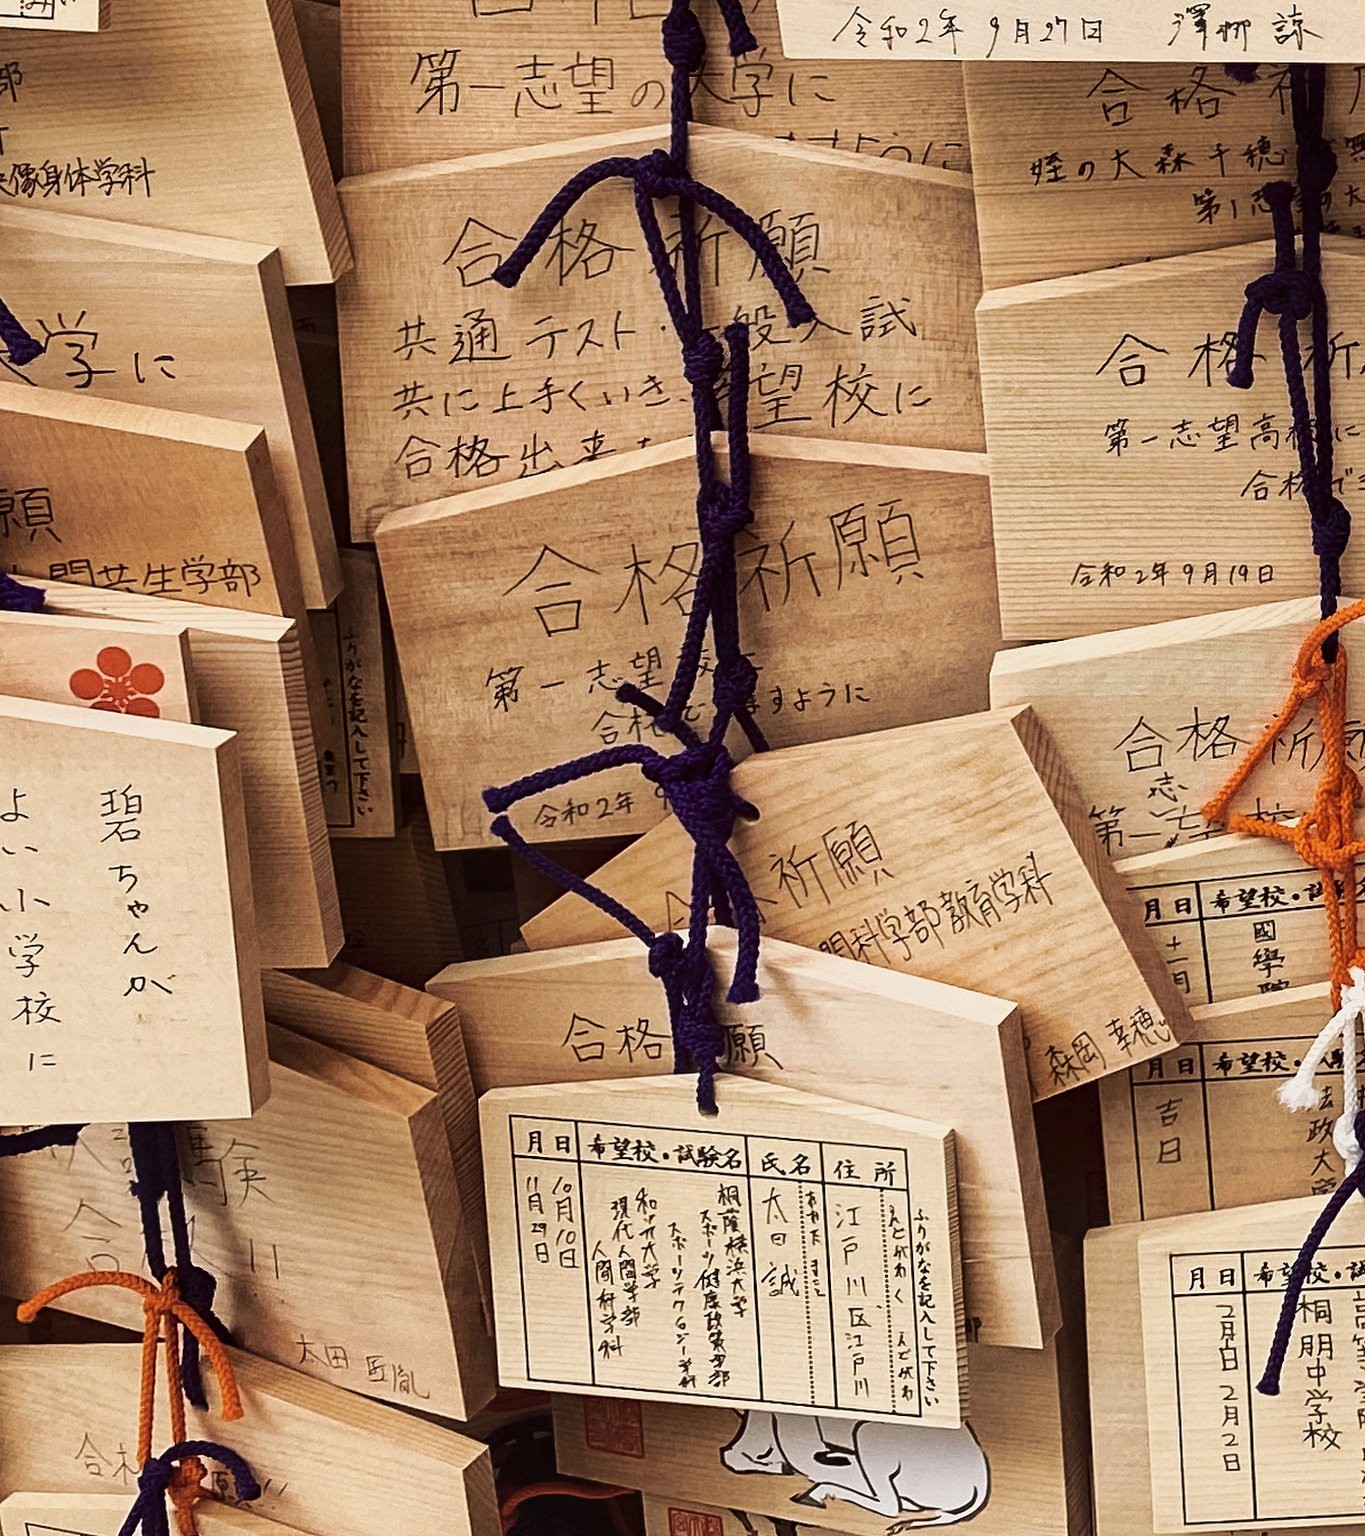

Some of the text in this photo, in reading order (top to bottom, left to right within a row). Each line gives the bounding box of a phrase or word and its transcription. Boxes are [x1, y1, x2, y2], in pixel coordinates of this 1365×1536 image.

[528, 1129, 570, 1153] 月日
[761, 1153, 811, 1175] 氏名
[833, 1161, 896, 1182] 住所
[1189, 1267, 1236, 1288] 月日
[913, 1208, 939, 1406] ふりがなを記入して下さい
